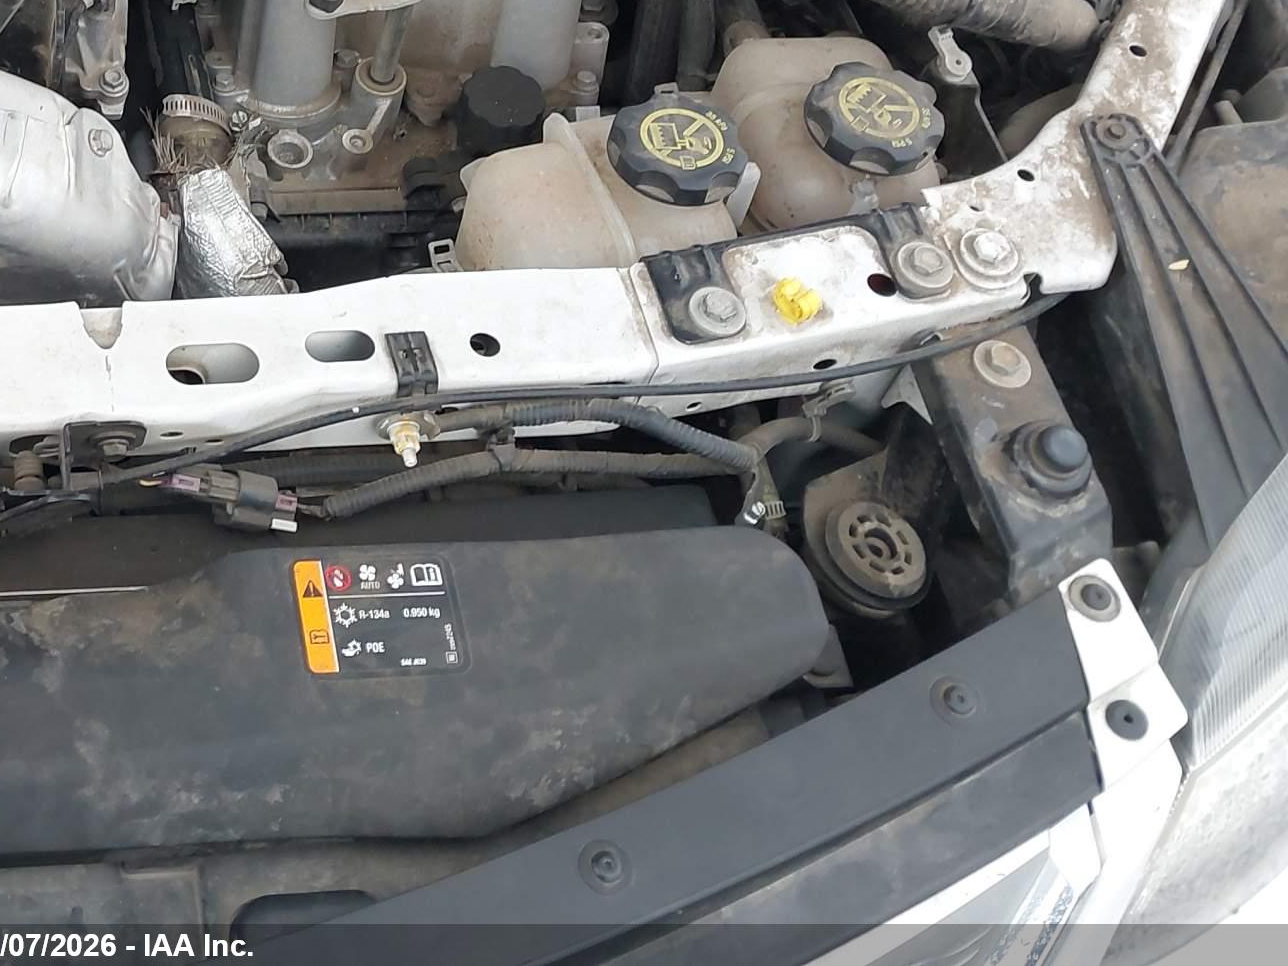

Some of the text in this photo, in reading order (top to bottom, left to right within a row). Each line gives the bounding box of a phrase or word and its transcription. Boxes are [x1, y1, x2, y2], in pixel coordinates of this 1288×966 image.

[361, 581, 381, 590] AUTO
[359, 606, 441, 619] R-134a 0.950 kg
[366, 642, 386, 653] POE
